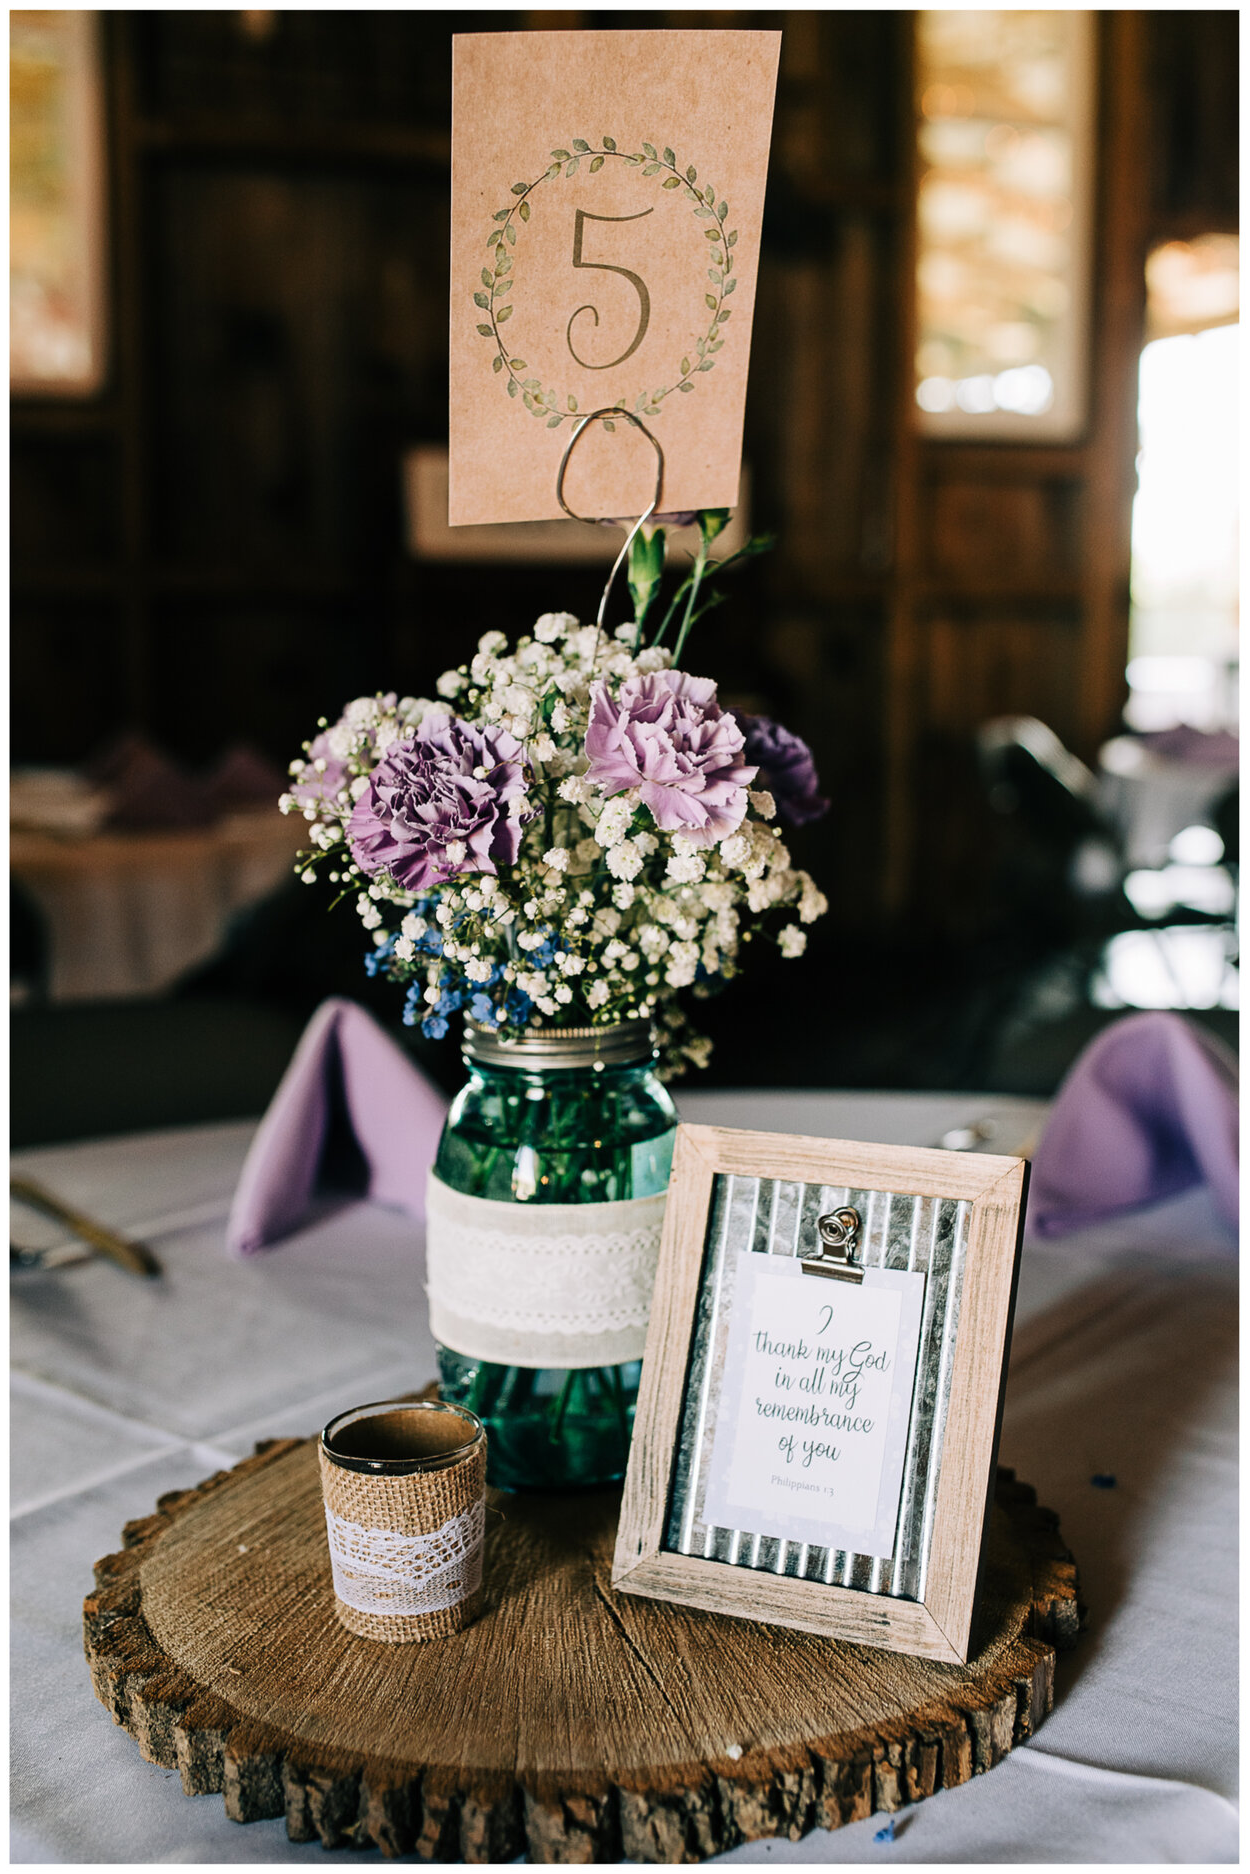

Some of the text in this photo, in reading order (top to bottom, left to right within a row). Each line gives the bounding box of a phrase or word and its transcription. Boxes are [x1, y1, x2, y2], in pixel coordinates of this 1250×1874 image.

[566, 206, 654, 369] 5
[752, 1331, 890, 1383] thank my God
[775, 1366, 862, 1410] in all my
[756, 1397, 874, 1433] remembrance
[778, 1434, 841, 1467] of you
[770, 1474, 820, 1492] Philippians
